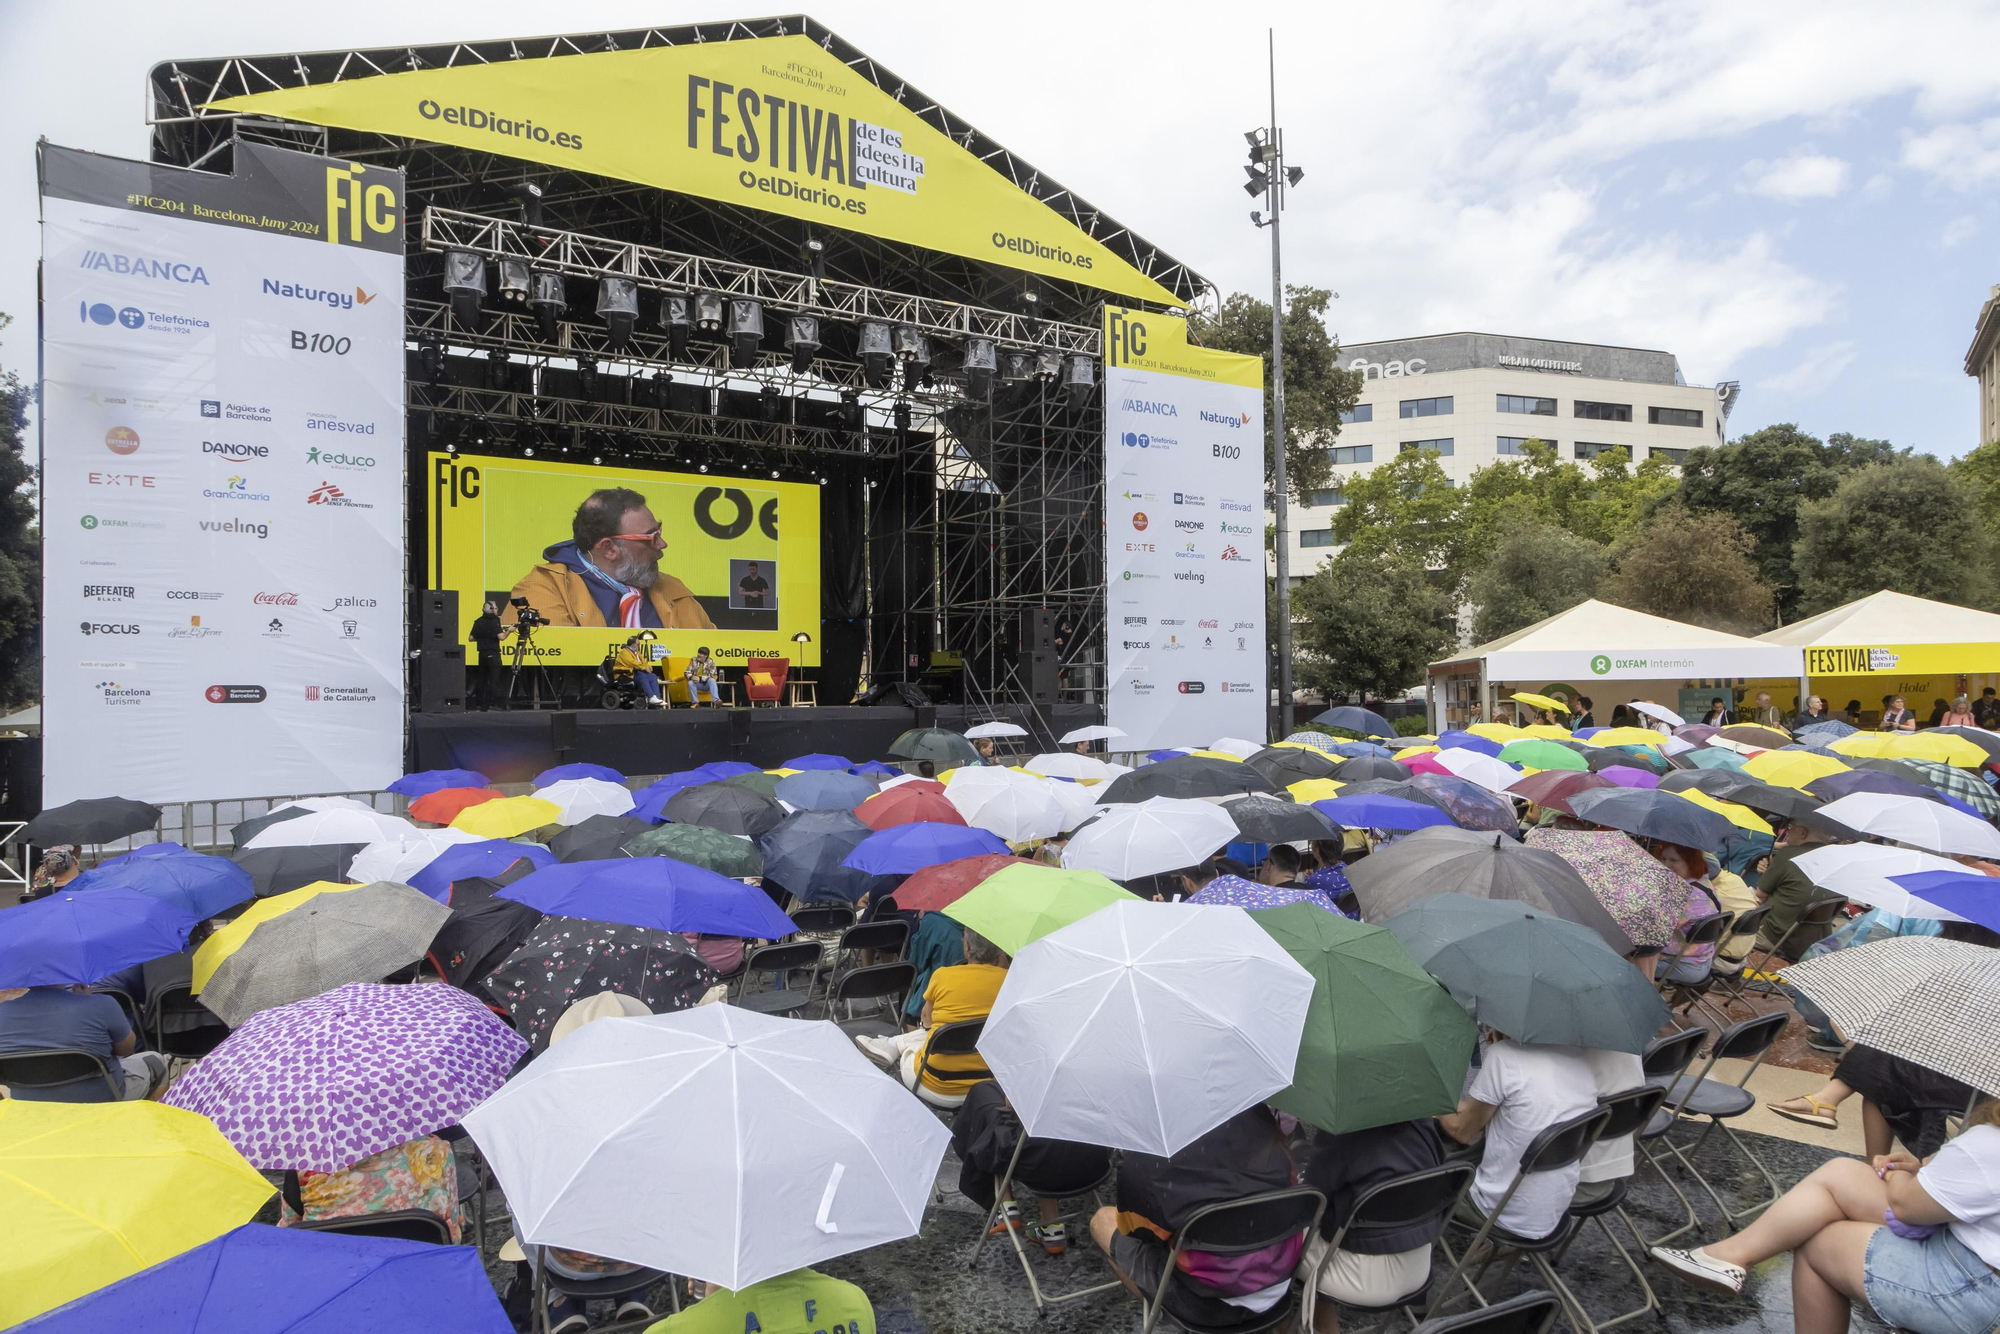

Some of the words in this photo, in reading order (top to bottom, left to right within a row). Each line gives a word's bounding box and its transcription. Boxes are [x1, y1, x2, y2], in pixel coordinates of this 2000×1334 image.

[688, 74, 866, 190] FESTIVAL
[856, 123, 877, 141] de
[880, 128, 902, 148] les
[856, 141, 899, 167] idees
[902, 154, 907, 170] i
[910, 156, 924, 174] la
[856, 165, 916, 191] cultura
[126, 193, 186, 213] #FIC204
[289, 221, 320, 236] 2024
[263, 279, 353, 309] Naturgy
[147, 312, 210, 328] Telefónica
[147, 324, 172, 333] desde
[291, 330, 351, 355] B100
[1348, 358, 1427, 381] fnac
[1499, 355, 1529, 367] URBAN
[1531, 358, 1582, 371] OUTFITTERS
[225, 403, 257, 414] Aigües
[259, 406, 270, 414] de
[226, 411, 272, 422] Barcelona
[1200, 410, 1241, 428] Naturgy
[306, 418, 375, 434] anesvad
[1213, 444, 1240, 459] B100
[322, 453, 375, 467] educo
[89, 472, 156, 488] EXTE
[203, 489, 270, 501] GranCanaria
[1220, 502, 1251, 512] anesvad
[102, 519, 128, 527] OXFAM
[199, 518, 268, 539] vueling
[1227, 525, 1252, 534] educo
[1126, 543, 1155, 552] EXTE
[1174, 570, 1205, 584] vueling
[83, 585, 135, 599] BEEFEATER
[166, 590, 199, 600] CCCB
[322, 596, 377, 612] galicia
[92, 624, 140, 635] FOCUS
[1616, 660, 1647, 668] OXFAM
[1651, 659, 1694, 668] Intermón
[1809, 648, 1875, 673] FESTIVAL
[1898, 681, 1930, 693] Hola!
[105, 697, 141, 705] Turisme
[805, 1299, 818, 1322] F
